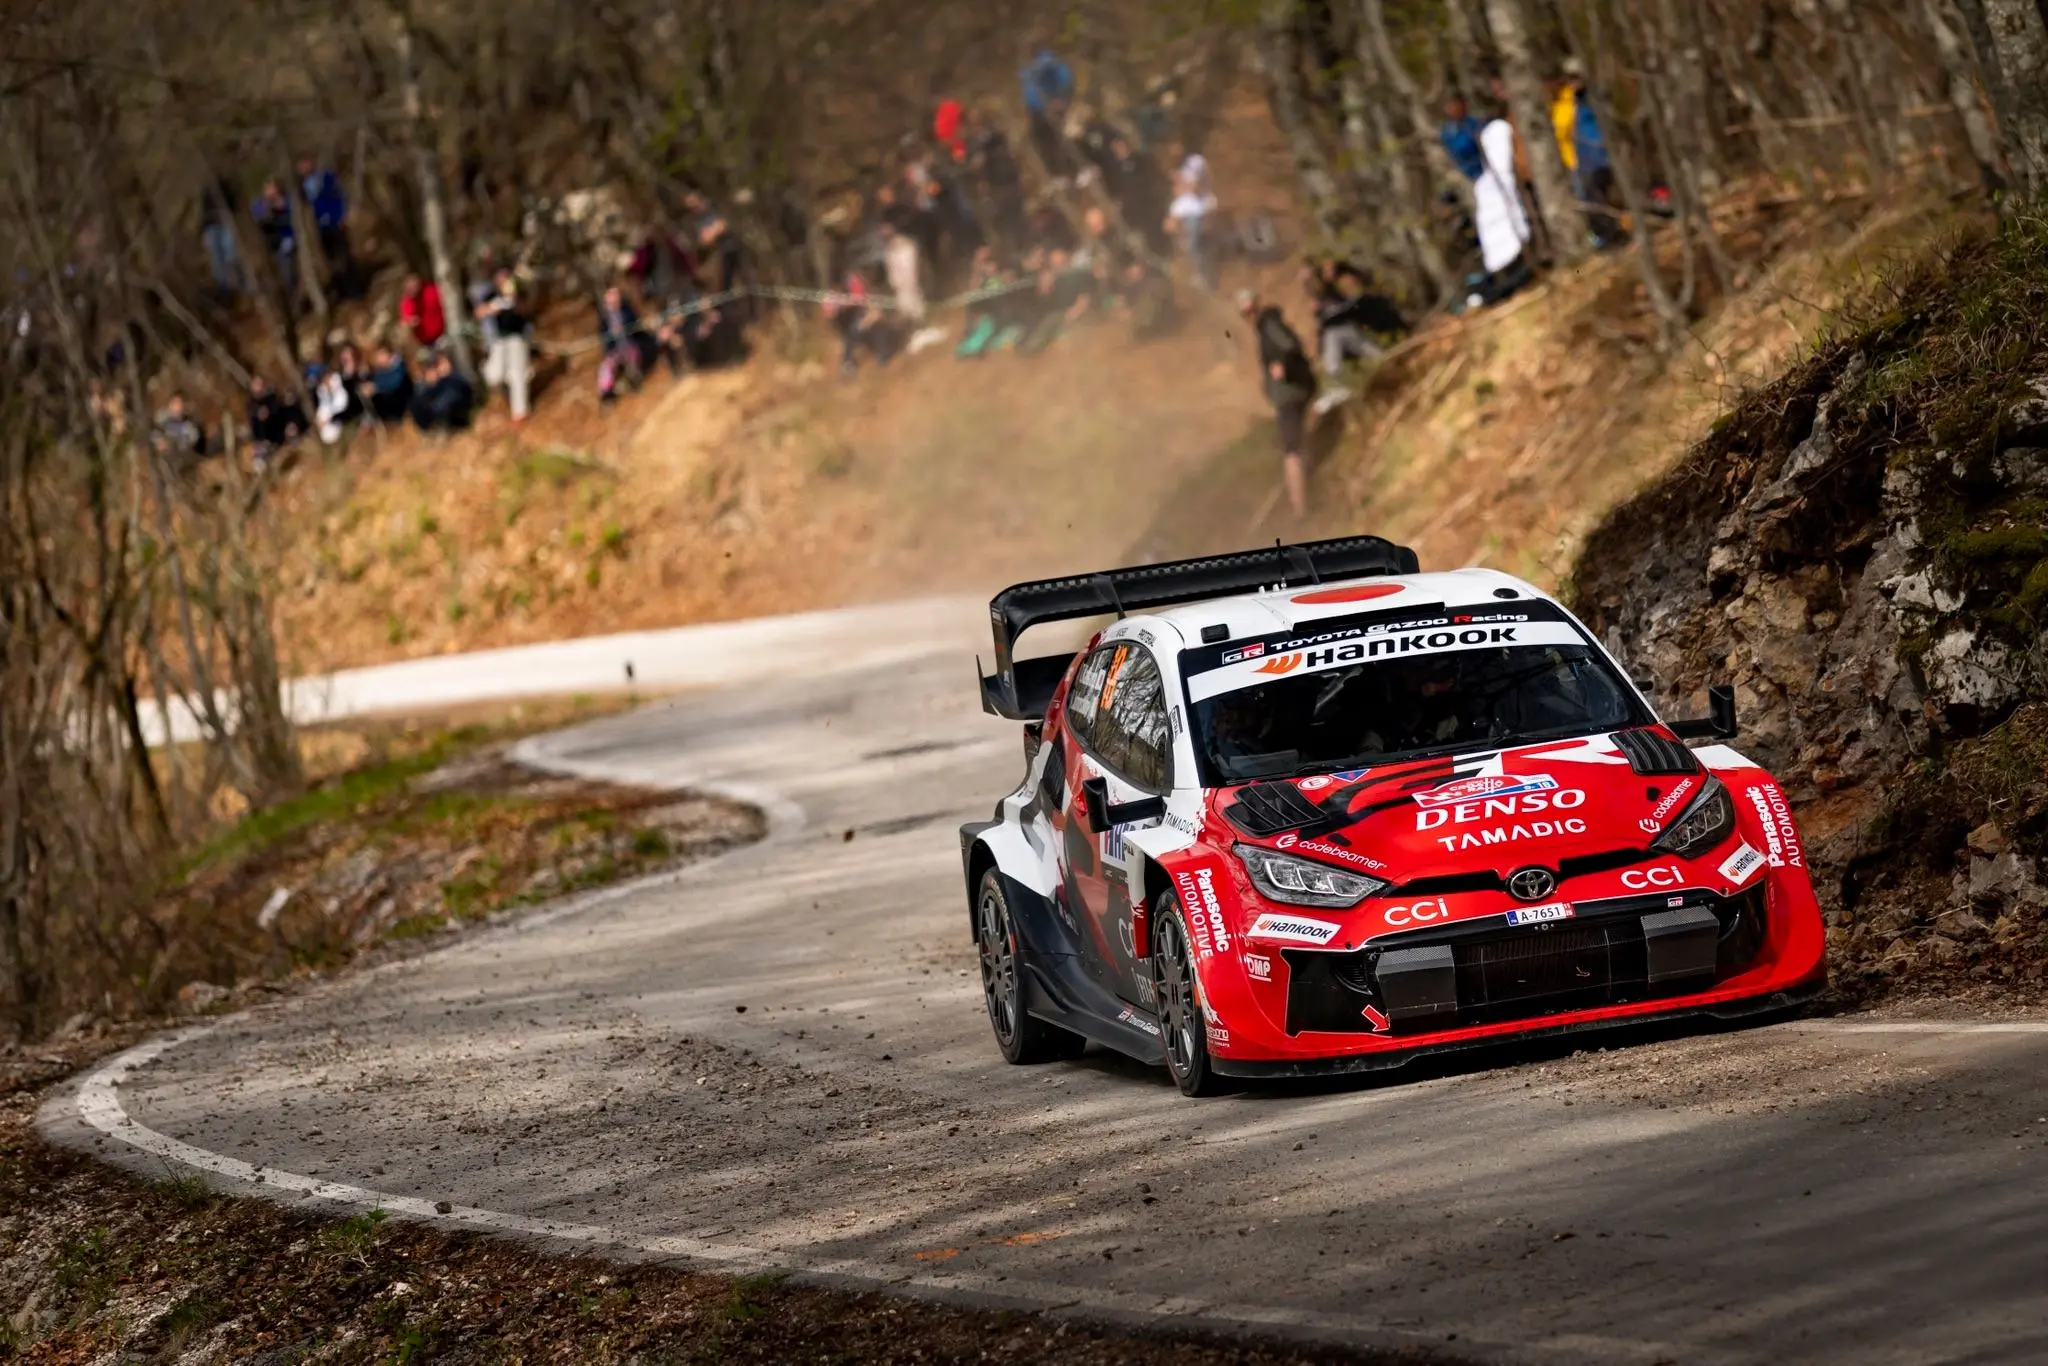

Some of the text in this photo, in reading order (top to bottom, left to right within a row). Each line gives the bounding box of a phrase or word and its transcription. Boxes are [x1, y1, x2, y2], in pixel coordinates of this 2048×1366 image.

[1224, 614, 1528, 663] GR TOYOTA GAZOO Racing
[1415, 789, 1586, 831] DENSO
[1653, 777, 1693, 818] codebeamer
[1165, 812, 1193, 834] TAMADIC
[1437, 818, 1587, 852] TAMADIC
[1745, 786, 1785, 867] Panasonic
[1762, 783, 1802, 867] AUTOMOTIVE
[1299, 840, 1384, 871] codebeamer
[1176, 872, 1214, 959] AUTOMOTIVE
[1194, 868, 1230, 952] Panasonic
[1521, 907, 1560, 921] A-7651
[1247, 957, 1271, 977] OMP
